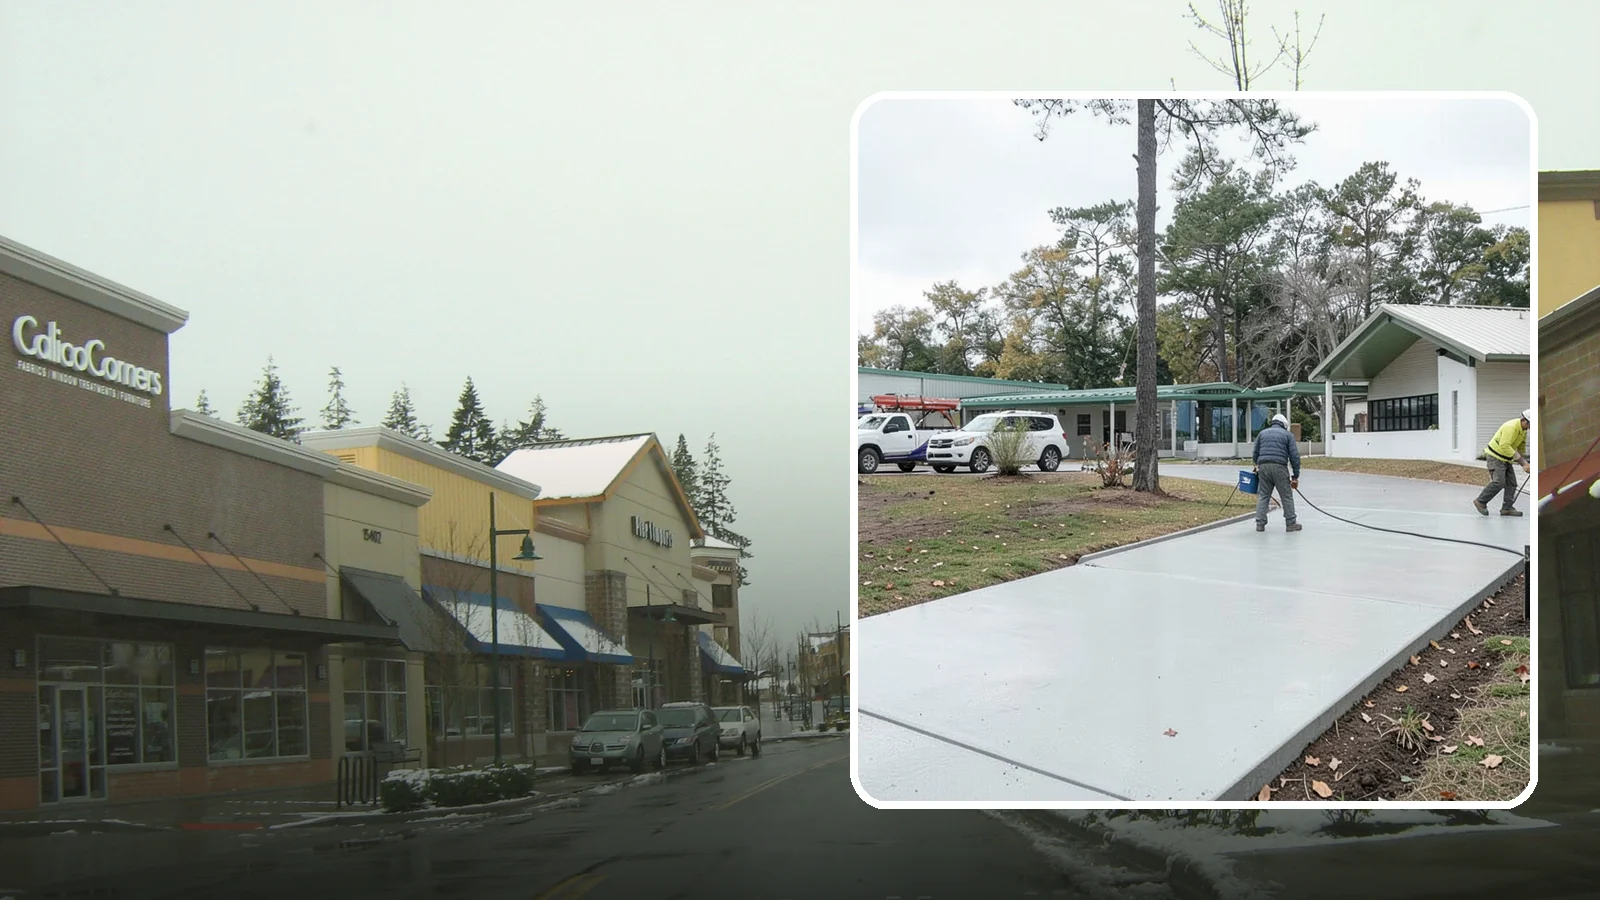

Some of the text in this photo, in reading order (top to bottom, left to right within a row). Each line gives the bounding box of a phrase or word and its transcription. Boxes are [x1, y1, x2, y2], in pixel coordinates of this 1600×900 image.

[17, 359, 151, 409] FABRICS WINDOW TREATMENTS FURNITURE
